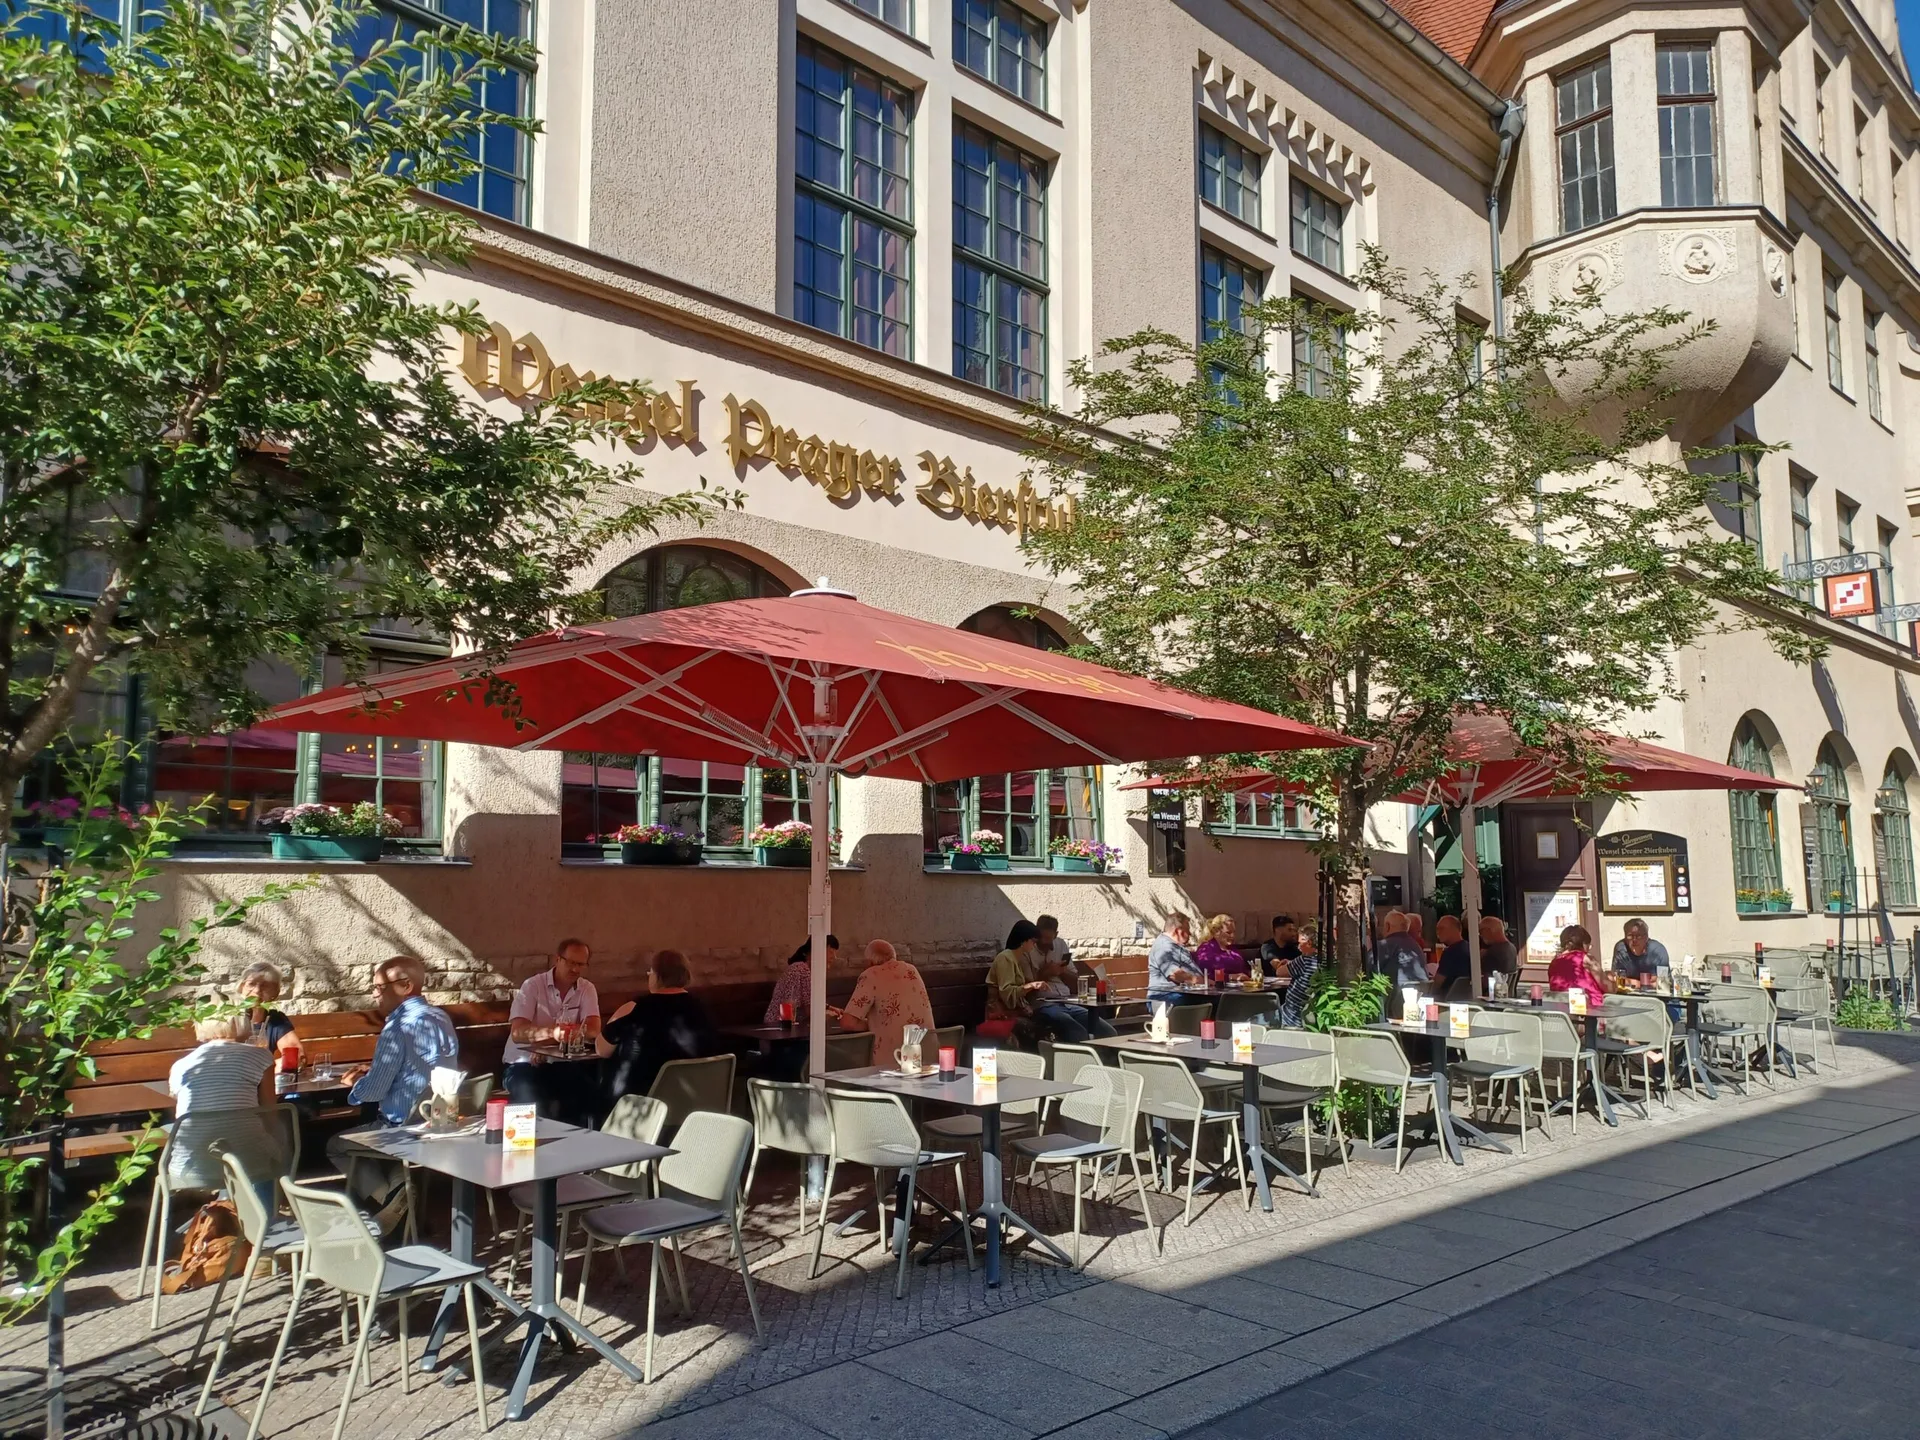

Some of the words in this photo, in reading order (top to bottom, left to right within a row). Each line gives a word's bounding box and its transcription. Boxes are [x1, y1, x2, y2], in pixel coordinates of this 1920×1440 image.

[722, 392, 902, 498] Prager
[1161, 812, 1180, 820] Wenzel
[1157, 821, 1178, 830] täglich
[1597, 848, 1620, 856] Wenzel
[1621, 848, 1643, 856] Prager
